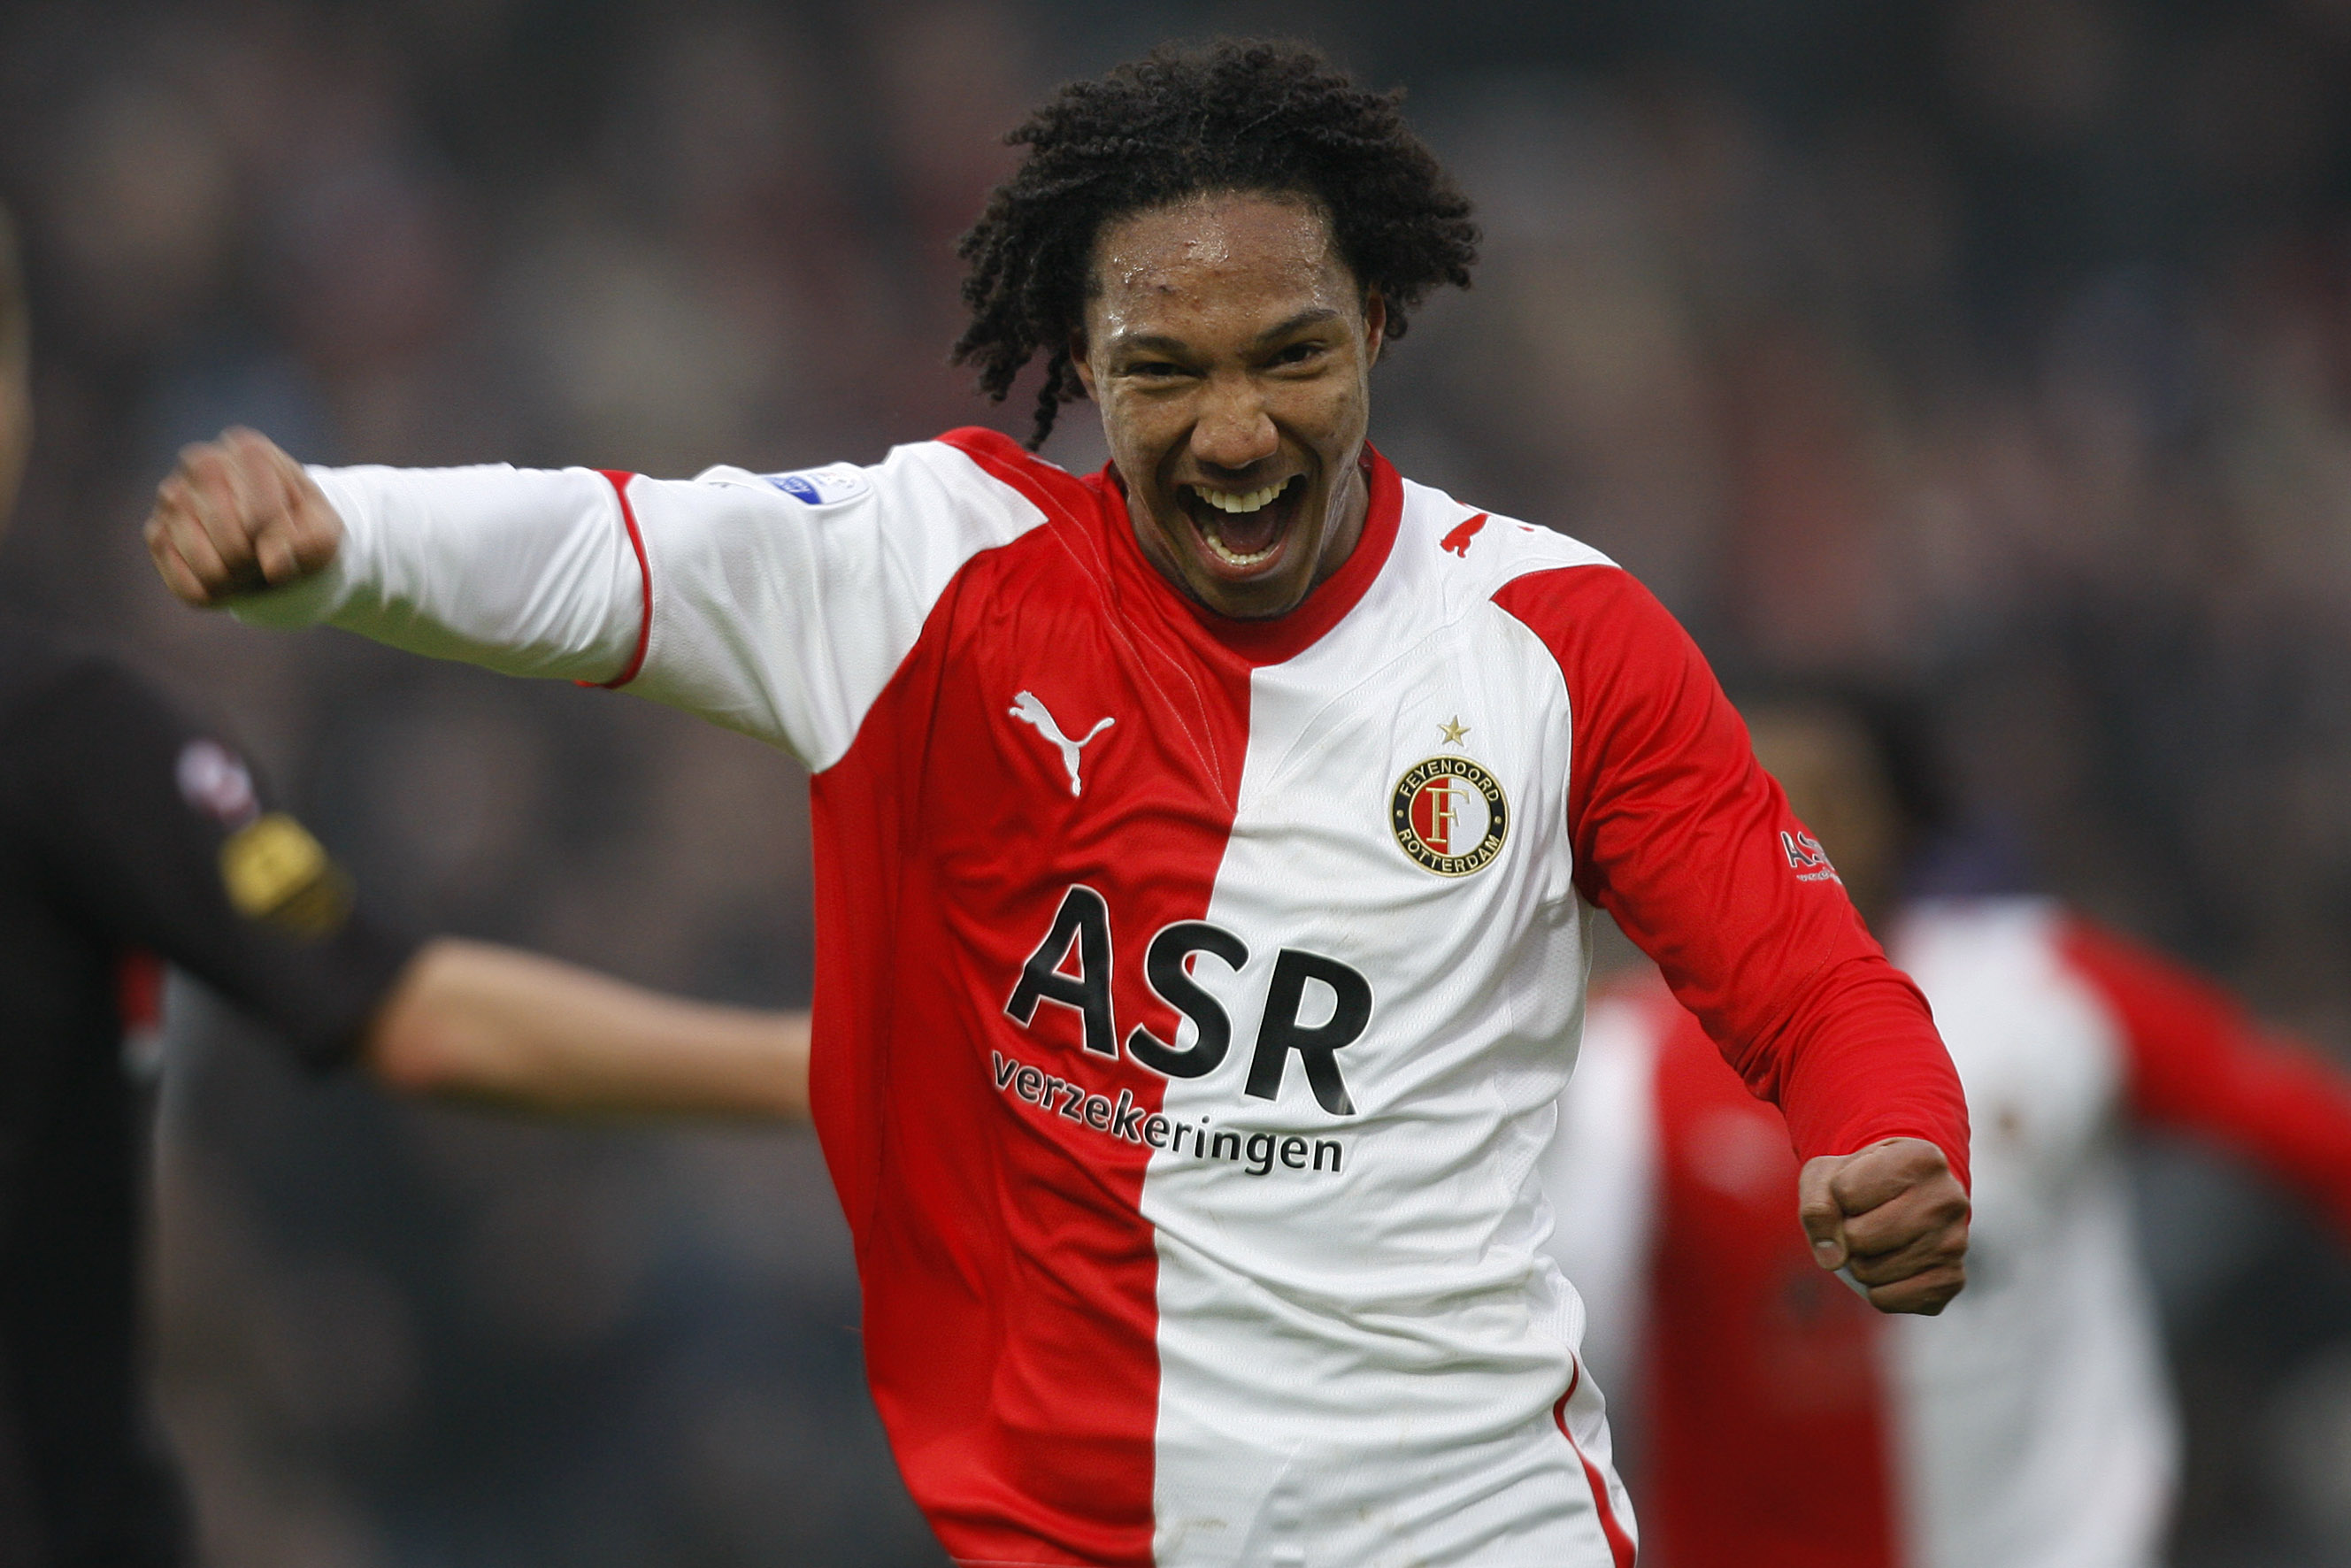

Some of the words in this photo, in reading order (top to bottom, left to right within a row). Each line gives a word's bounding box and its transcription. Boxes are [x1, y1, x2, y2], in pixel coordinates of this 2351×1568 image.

[1399, 759, 1499, 802] FEYENOORD
[1425, 787, 1470, 843] F
[1398, 828, 1500, 872] ROTTERDAM
[1780, 831, 1835, 871] AS
[1003, 883, 1375, 1117] ASR
[993, 1050, 1344, 1177] verzekeringen
